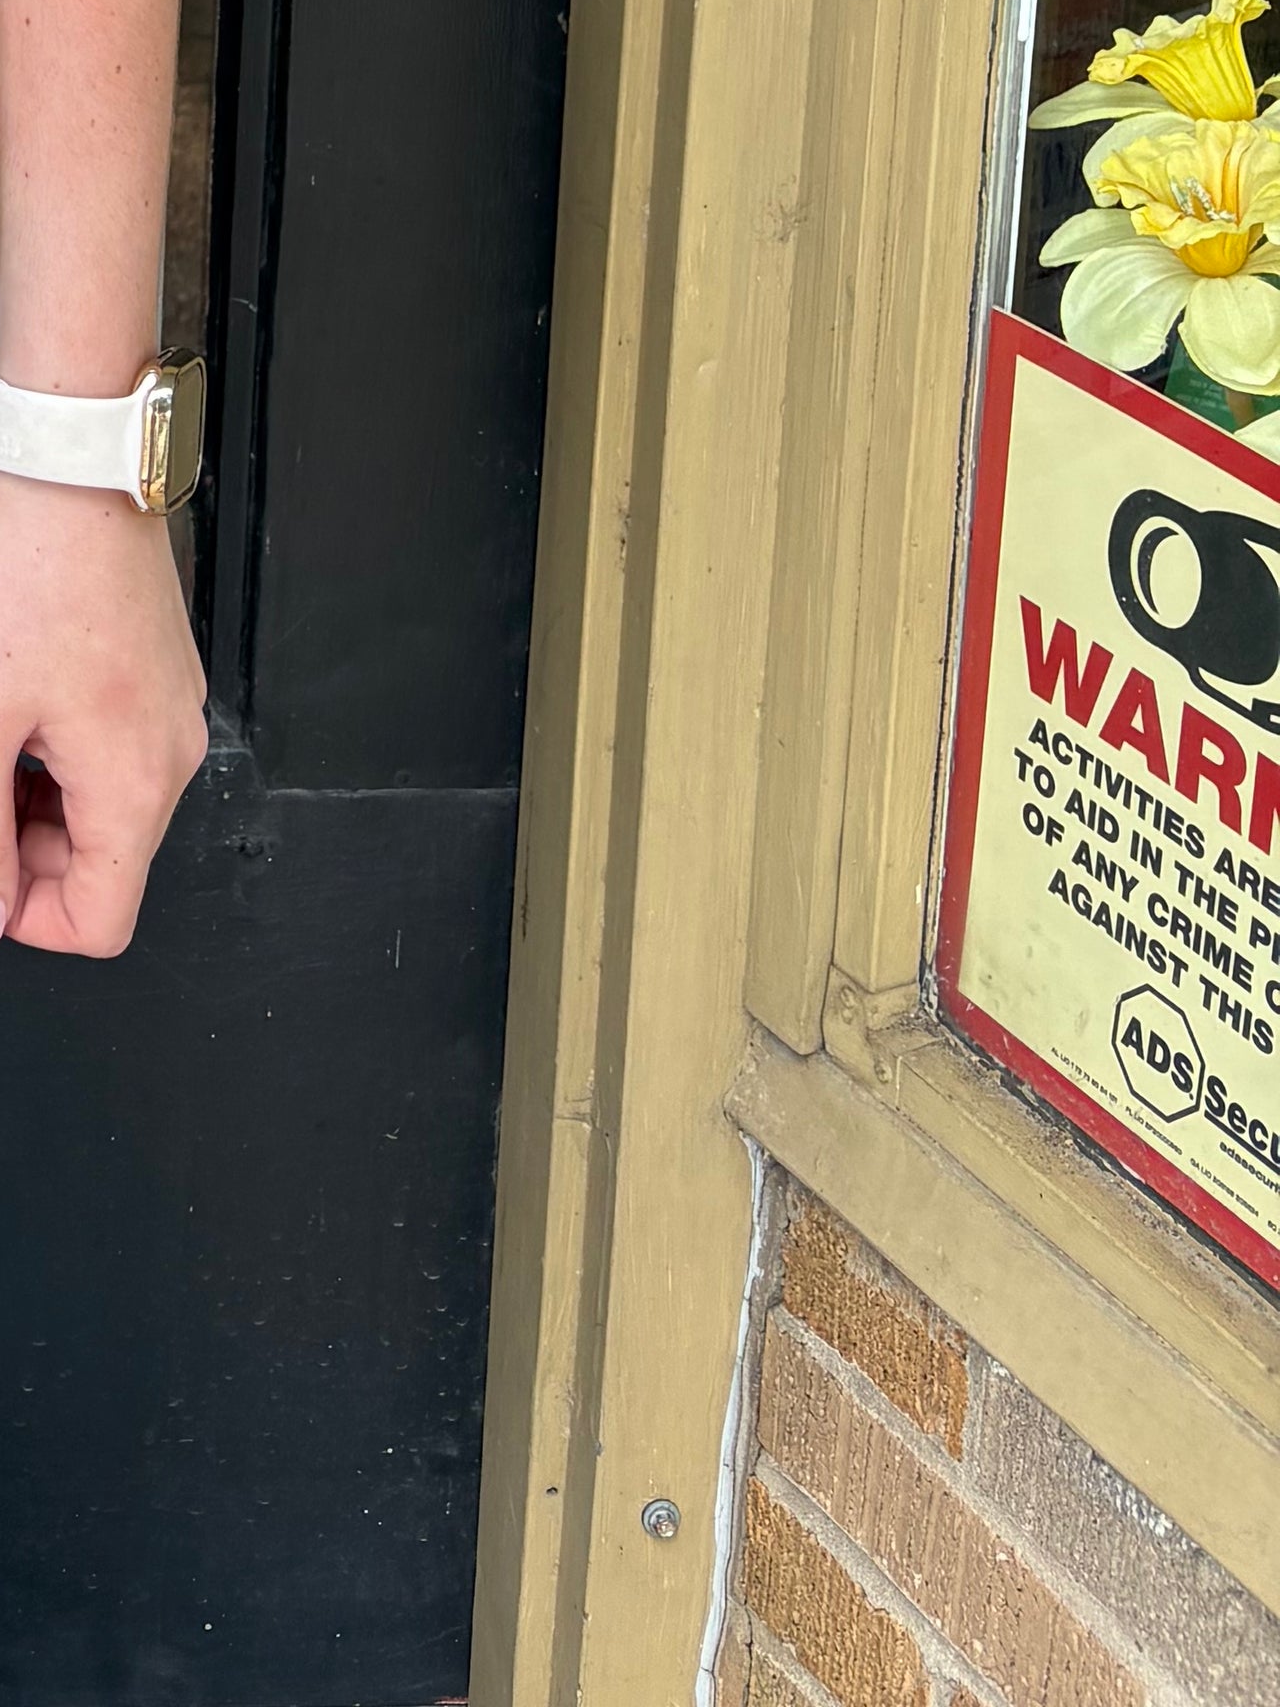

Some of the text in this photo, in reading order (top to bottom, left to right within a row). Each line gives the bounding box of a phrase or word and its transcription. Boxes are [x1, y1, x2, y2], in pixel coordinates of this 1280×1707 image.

[1014, 747, 1056, 798] TO
[1064, 788, 1120, 843] AID
[1130, 830, 1163, 878] IN
[1174, 860, 1239, 934] THE
[1023, 803, 1065, 846] OF
[1072, 840, 1139, 903] ANY
[1148, 892, 1254, 994] CRIME
[1028, 718, 1280, 918] ACTIVITIES ARE
[1048, 868, 1274, 1055] AGAINST THIS
[1121, 1016, 1194, 1093] ADS
